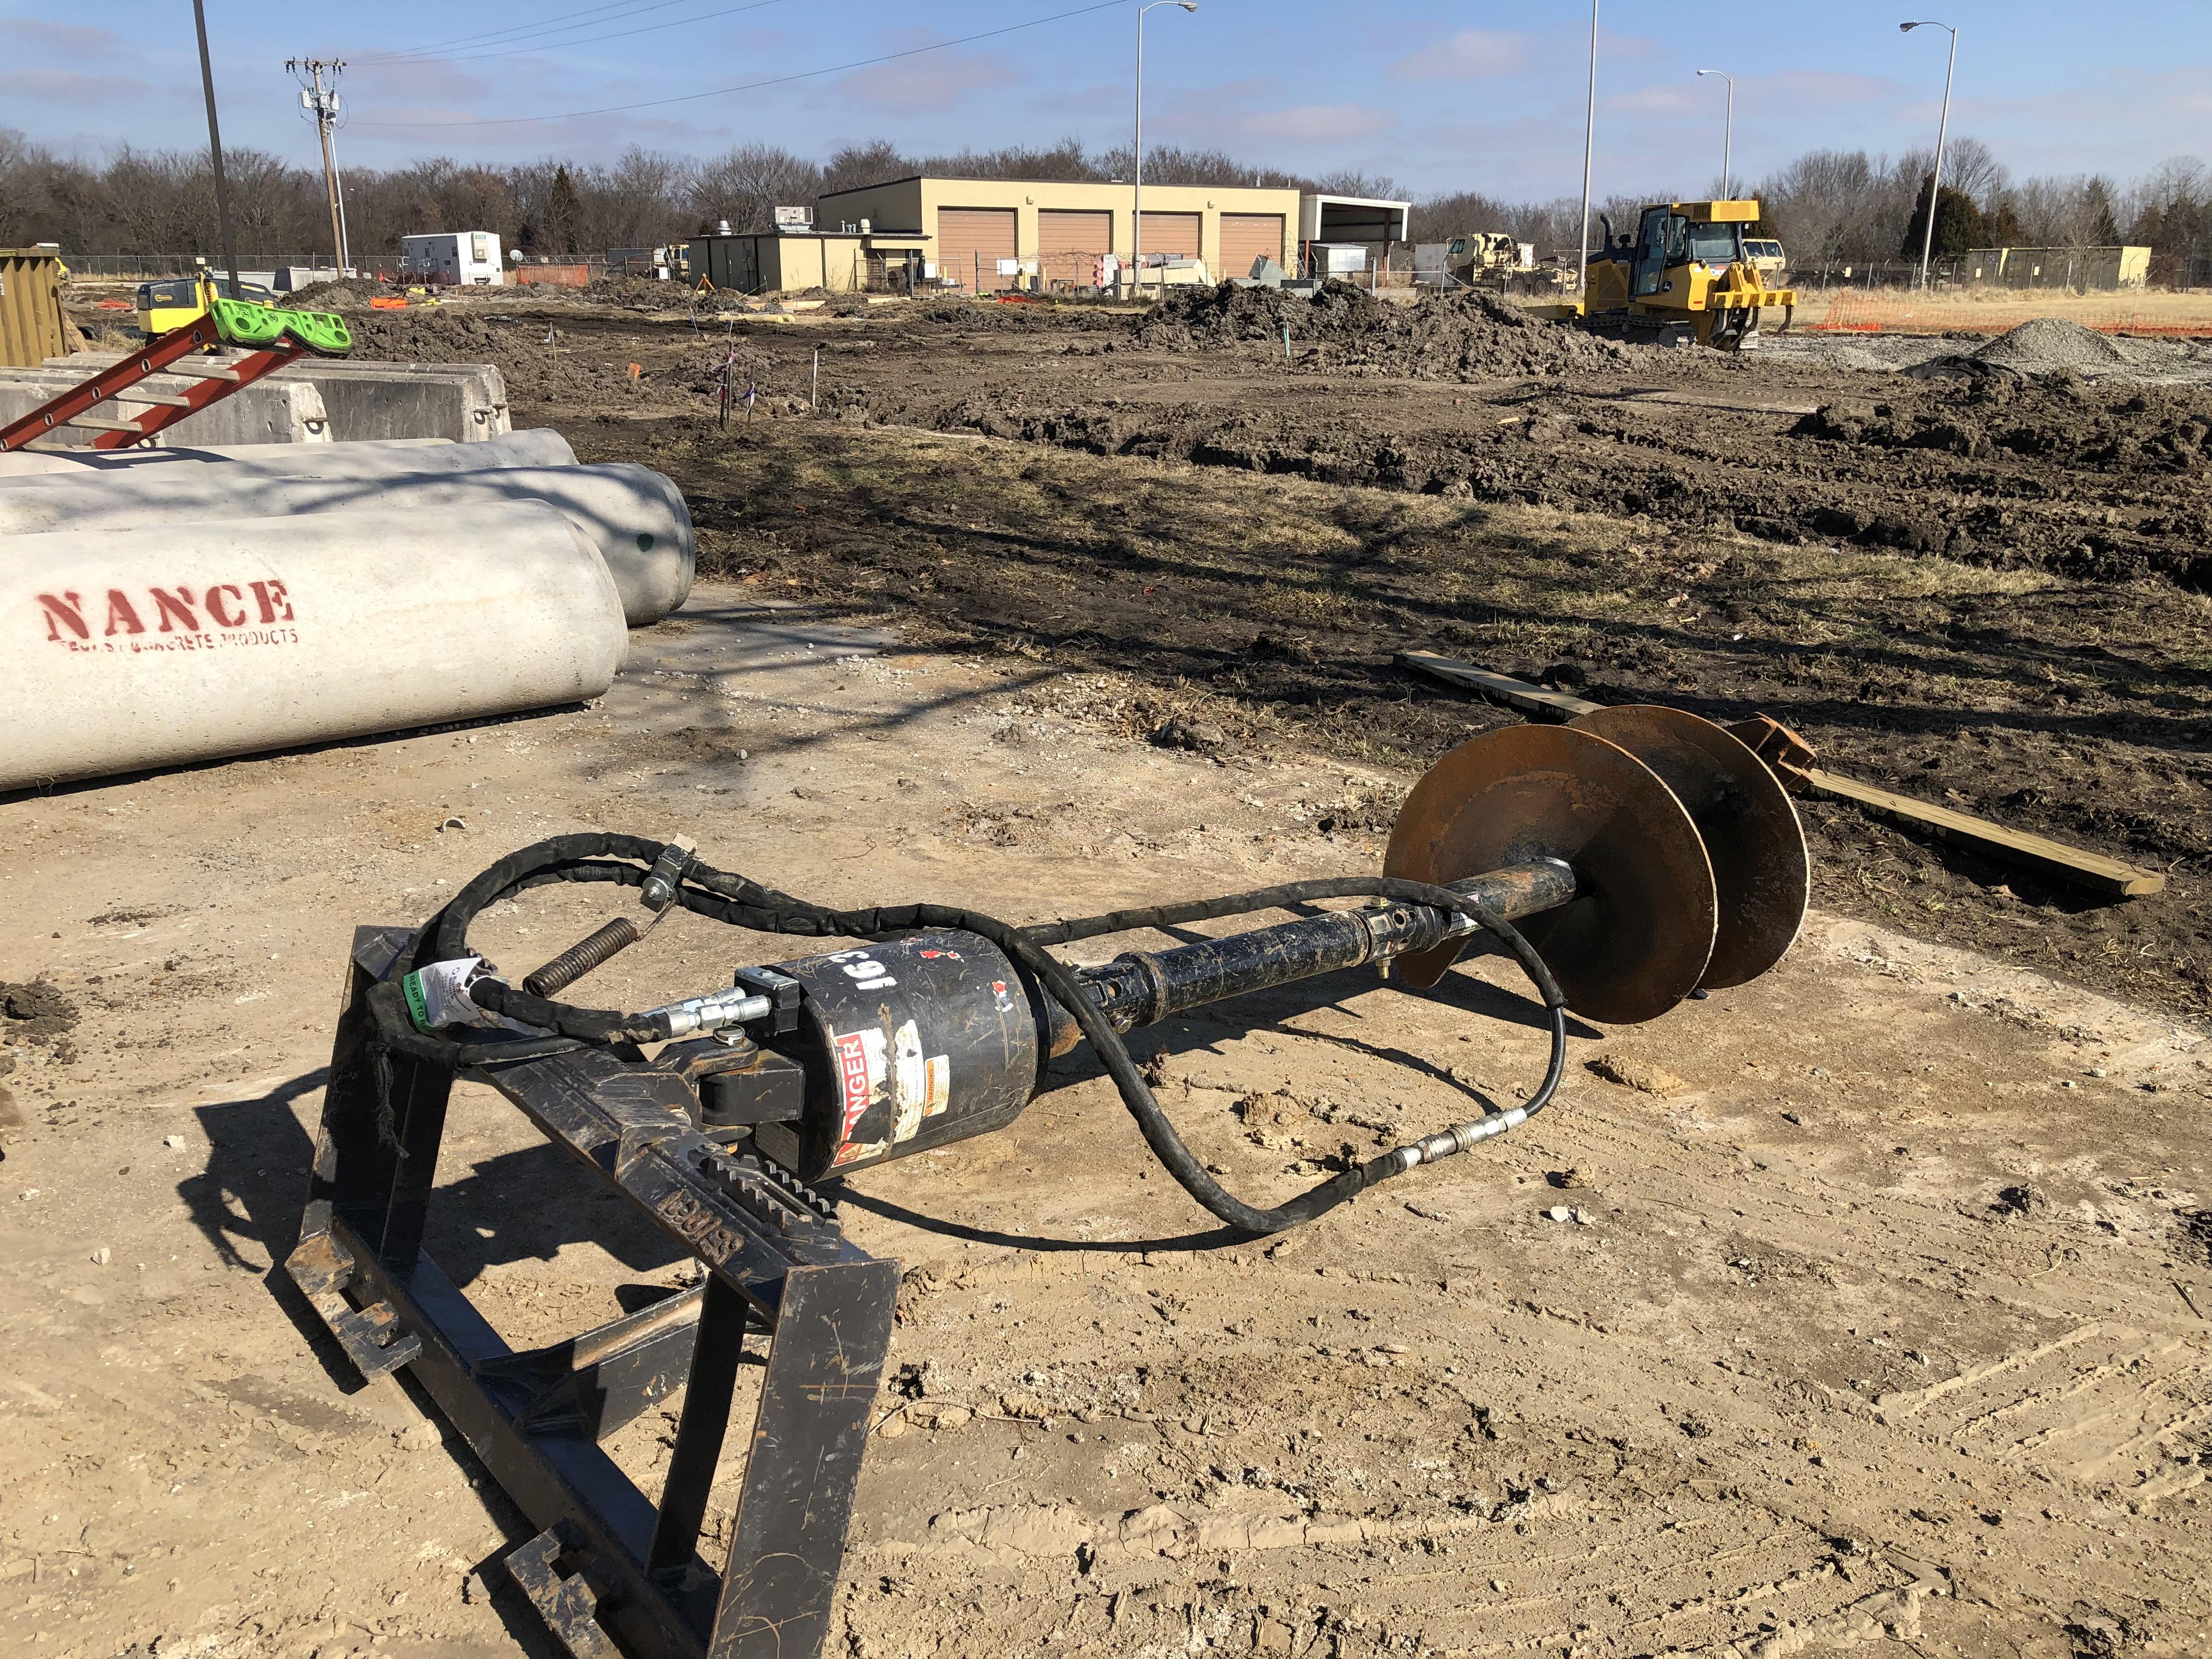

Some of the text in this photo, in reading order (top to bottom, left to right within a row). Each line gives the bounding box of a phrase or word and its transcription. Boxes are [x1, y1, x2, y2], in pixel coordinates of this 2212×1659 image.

[37, 579, 295, 641] NANCE
[221, 629, 298, 648] PRODUCTS
[828, 951, 898, 990] 163
[409, 975, 425, 1017] READY TO
[843, 1039, 867, 1140] ANGER
